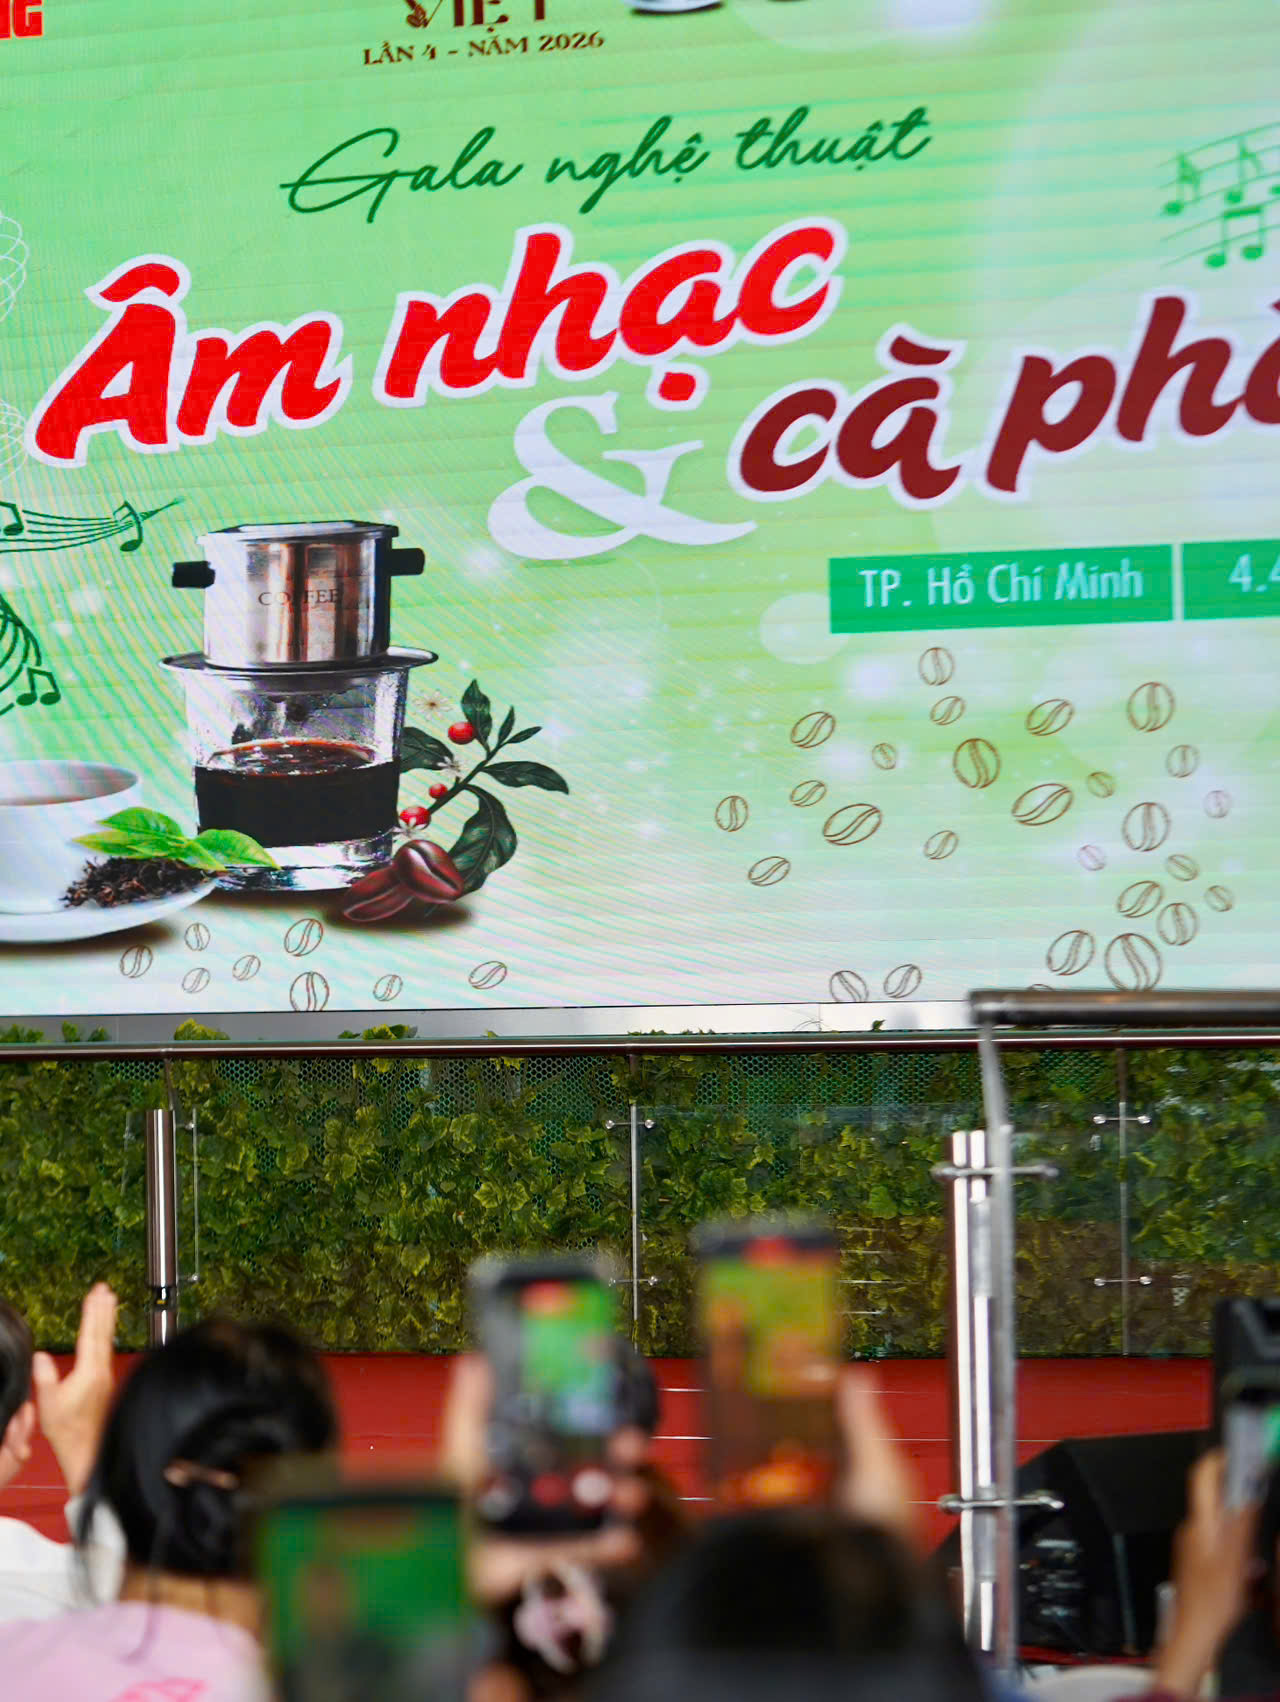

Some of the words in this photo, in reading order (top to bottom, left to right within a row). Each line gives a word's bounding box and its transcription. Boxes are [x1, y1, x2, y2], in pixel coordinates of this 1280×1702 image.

[421, 44, 438, 61] 4
[537, 31, 606, 52] 2026
[280, 126, 524, 224] Gala
[545, 115, 711, 214] nghệ
[735, 105, 932, 170] thuật
[33, 260, 344, 461] Âm
[382, 225, 836, 402] nhạc
[487, 391, 758, 560] &
[738, 334, 962, 500] cà
[858, 567, 913, 608] TP.
[927, 563, 976, 606] Hồ
[986, 562, 1045, 604] Chí
[1053, 556, 1145, 600] Minh
